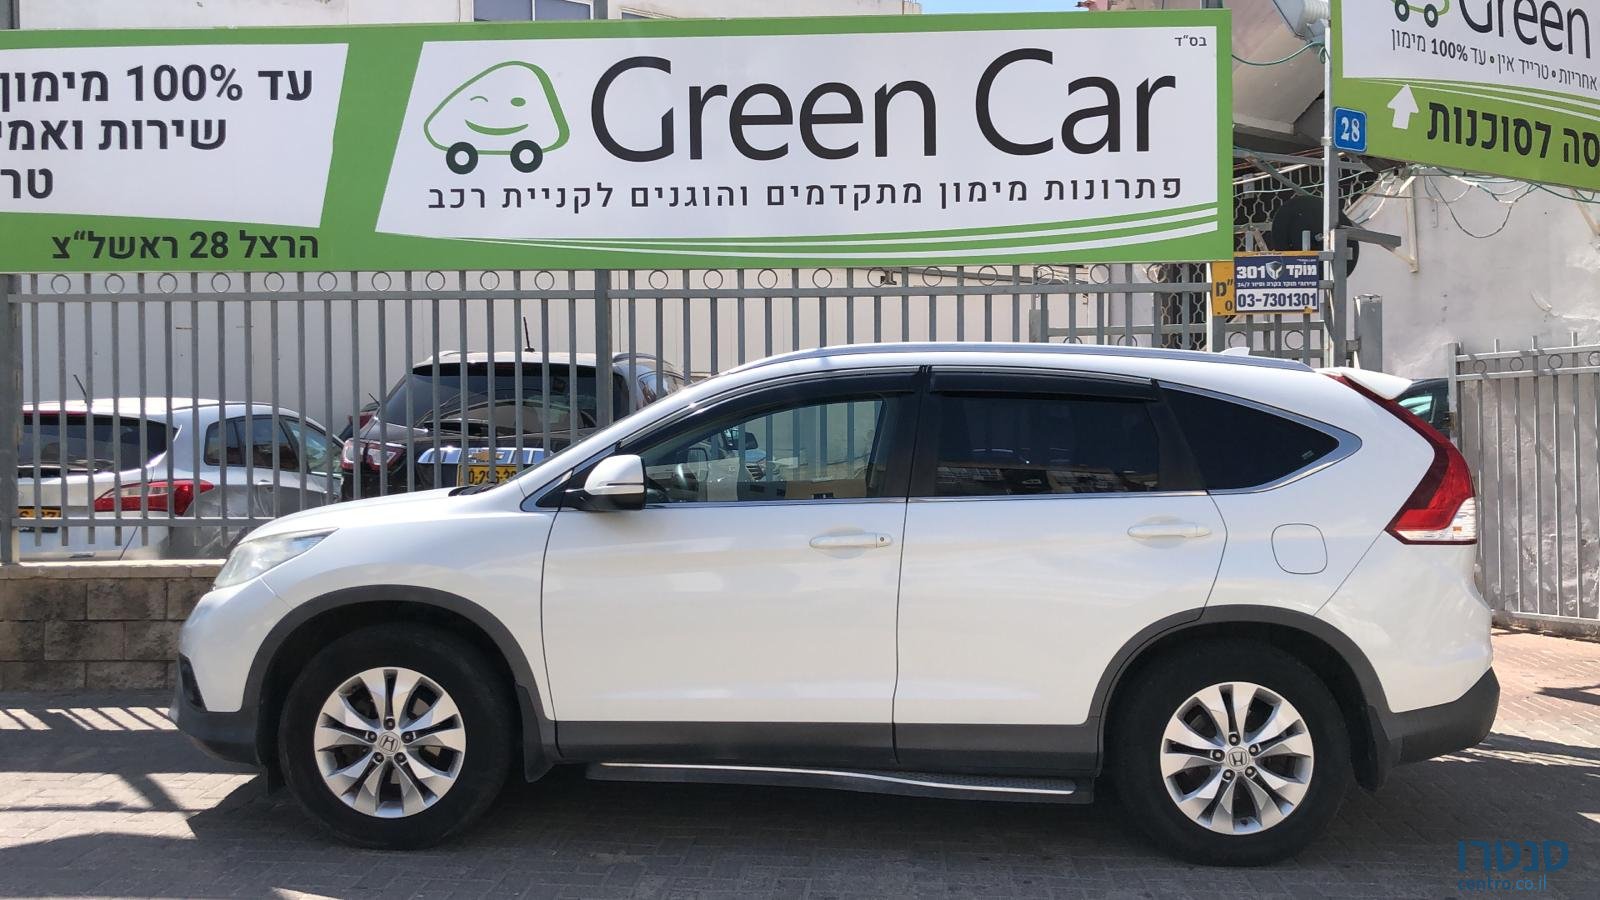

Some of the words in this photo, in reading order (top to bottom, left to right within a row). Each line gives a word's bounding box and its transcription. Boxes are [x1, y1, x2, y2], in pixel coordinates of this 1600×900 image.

[1174, 34, 1208, 47] בס"ד
[1391, 29, 1426, 52] מימון
[1431, 38, 1468, 62] 100%
[1470, 47, 1487, 66] עד
[1497, 54, 1515, 75] אין
[1518, 59, 1549, 80] טרייד
[1558, 68, 1598, 91] אחריות
[0, 70, 109, 112] מימון
[127, 64, 243, 102] 100%
[257, 70, 313, 101] עד
[591, 56, 936, 162] Green
[975, 48, 1176, 156] Car
[98, 119, 227, 151] שירות
[1340, 116, 1360, 142] 28
[1426, 101, 1552, 159] לסוכנות
[428, 188, 486, 208] רכב
[501, 182, 613, 214] לקניית
[631, 186, 748, 208] והוגנים
[766, 183, 922, 211] מתקדמים
[939, 180, 1027, 210] מימון
[1043, 177, 1181, 201] פתרונות
[51, 230, 179, 260] ראשל"צ
[189, 231, 229, 259] 28
[239, 230, 319, 260] הרצל
[1236, 265, 1266, 279] 301
[1286, 263, 1317, 278] מוקד
[1238, 293, 1317, 307] 03-7301301
